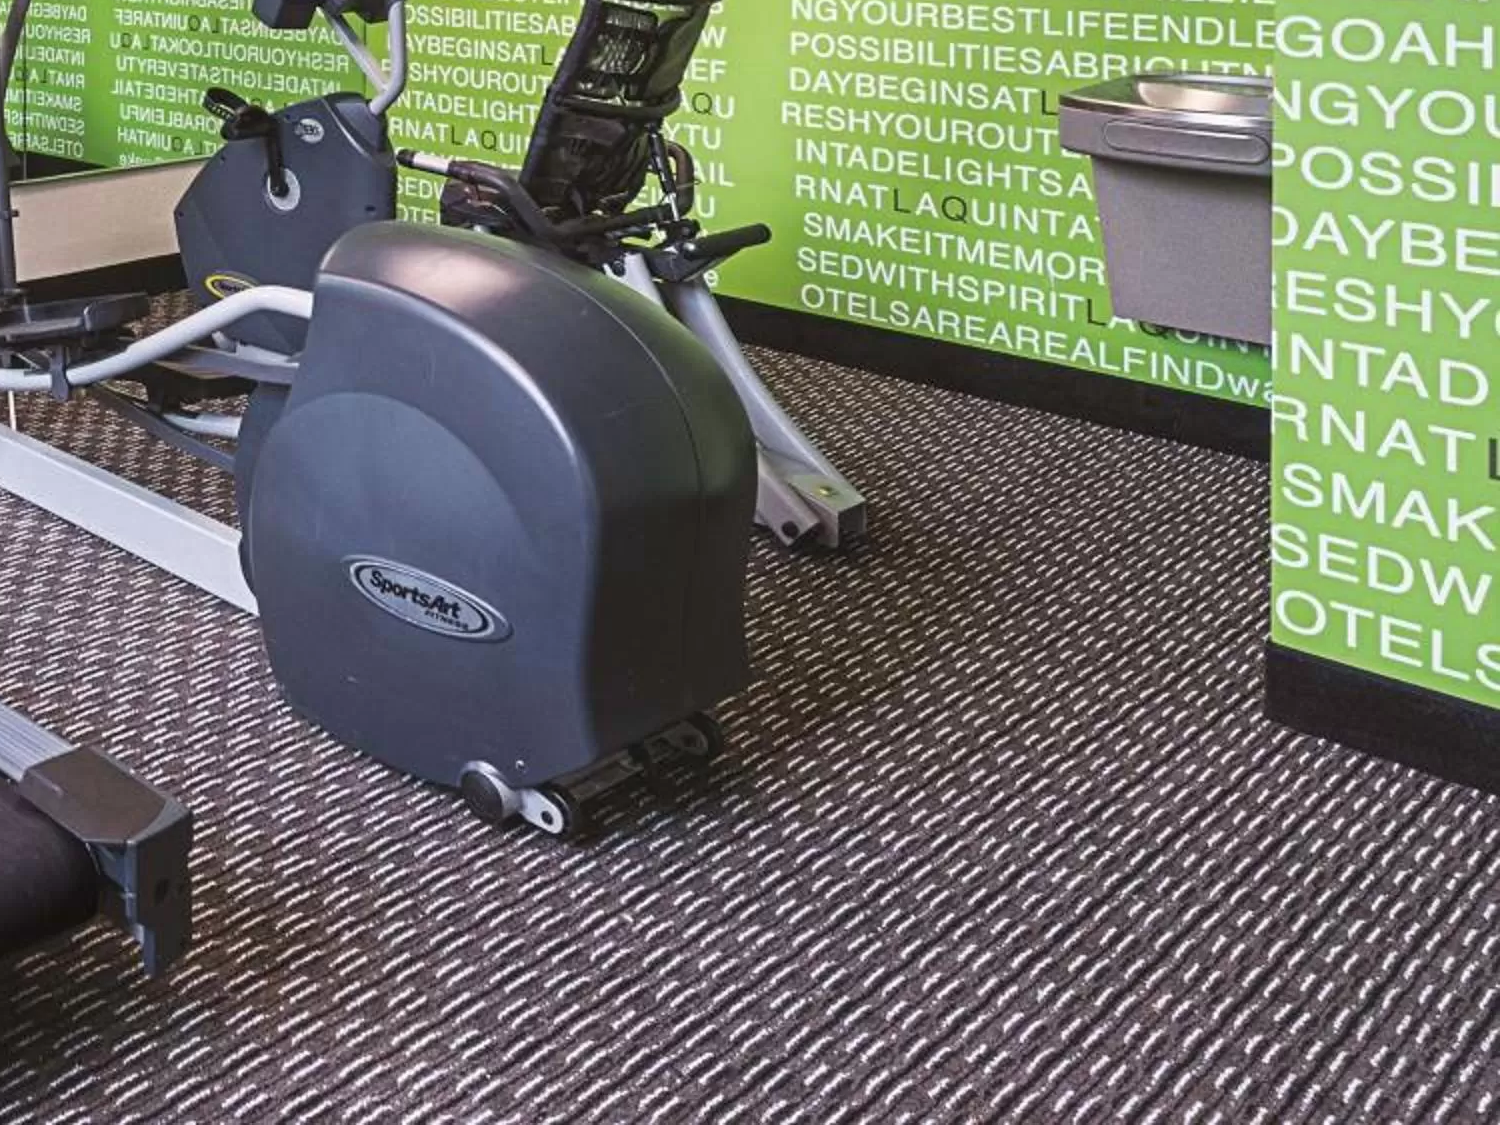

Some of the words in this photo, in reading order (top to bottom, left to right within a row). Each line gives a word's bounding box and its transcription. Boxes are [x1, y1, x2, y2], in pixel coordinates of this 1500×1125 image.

[1275, 15, 1493, 70] GOAH
[781, 101, 1058, 154] RESHYOUROUT
[1272, 142, 1500, 208] POSSI
[1273, 269, 1500, 340] ESHY
[1282, 462, 1497, 552] SMAK
[368, 569, 461, 620] SportsArt
[1271, 523, 1493, 616] SEDW
